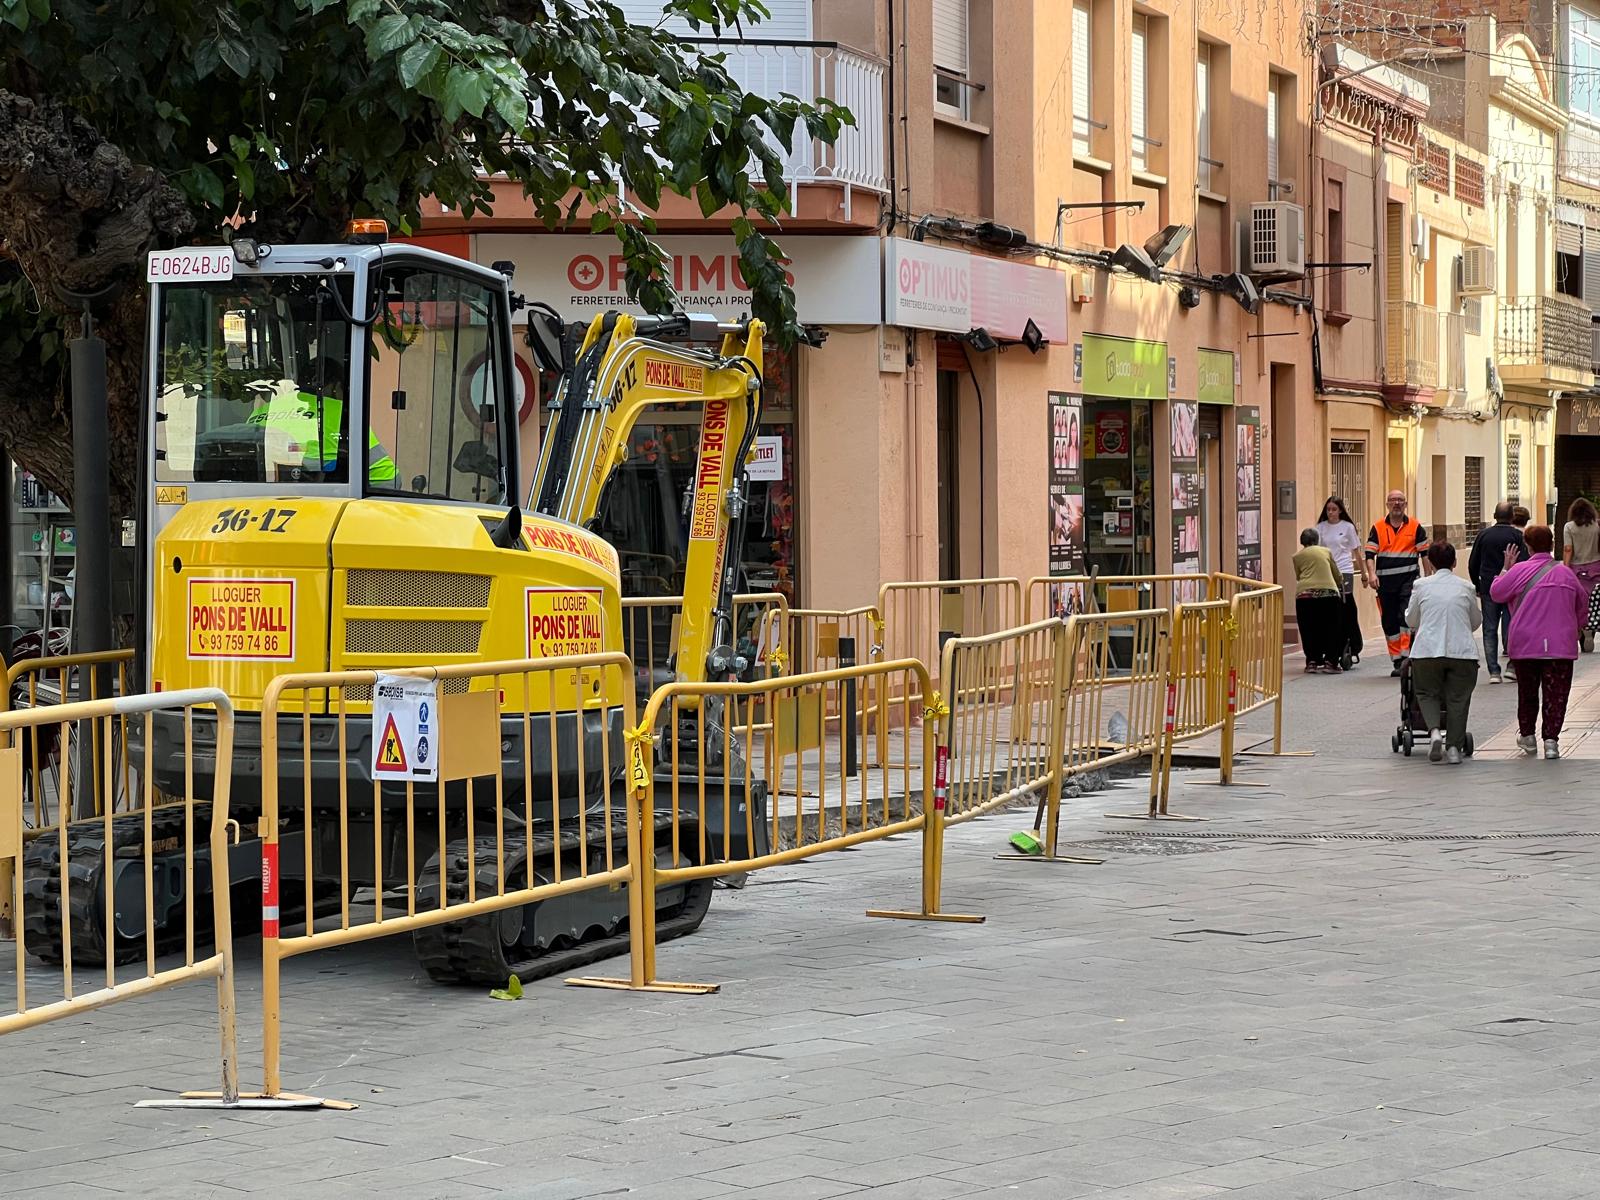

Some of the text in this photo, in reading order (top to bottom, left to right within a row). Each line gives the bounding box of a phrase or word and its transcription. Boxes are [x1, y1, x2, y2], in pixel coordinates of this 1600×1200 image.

[899, 258, 968, 303] OPTIMUS
[570, 296, 640, 305] FERRETERIES
[646, 361, 662, 385] PONS
[662, 364, 671, 386] DE
[671, 364, 685, 388] VALL
[699, 400, 728, 489] ONS DE VALL
[697, 492, 706, 501] 93
[695, 502, 705, 516] 759
[702, 493, 718, 537] LLOGUER
[694, 517, 704, 526] 74
[525, 526, 565, 551] PONS
[560, 530, 580, 555] DE
[575, 535, 604, 565] VALL
[717, 528, 726, 556] PONS
[212, 587, 261, 603] LLOGUER
[552, 596, 587, 612] LLOGUER
[193, 606, 287, 632] PONS DE VALL
[532, 615, 600, 640] PONS DE VALL
[210, 634, 278, 651] 93 759 74 86
[553, 642, 597, 657] 93 759 74 86
